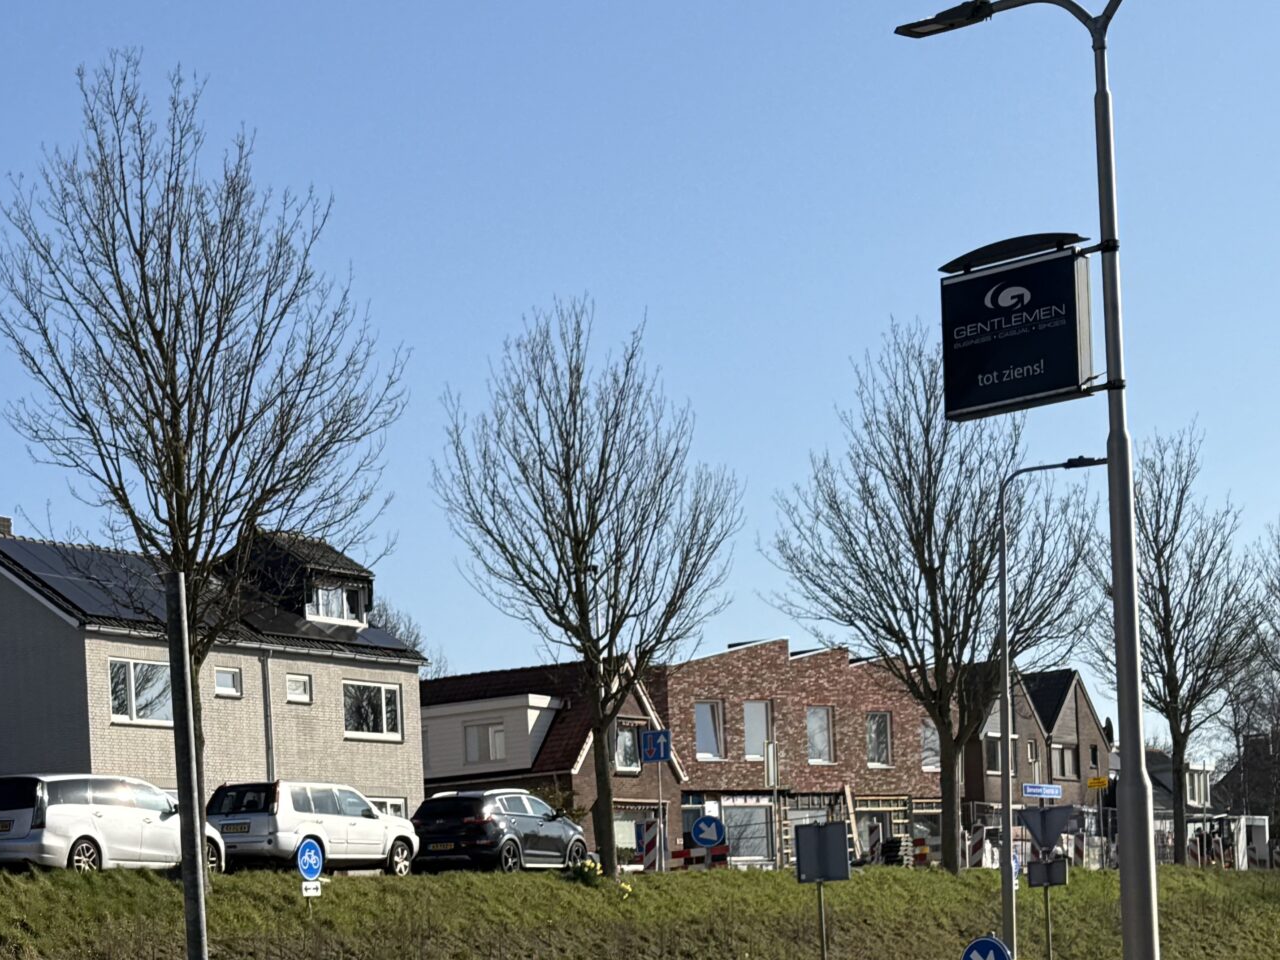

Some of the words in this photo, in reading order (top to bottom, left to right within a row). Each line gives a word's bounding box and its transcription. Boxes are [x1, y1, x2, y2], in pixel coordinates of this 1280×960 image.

[953, 303, 1066, 339] GENTLEMEN
[977, 370, 999, 387] tot
[1002, 359, 1044, 382] ziens!
